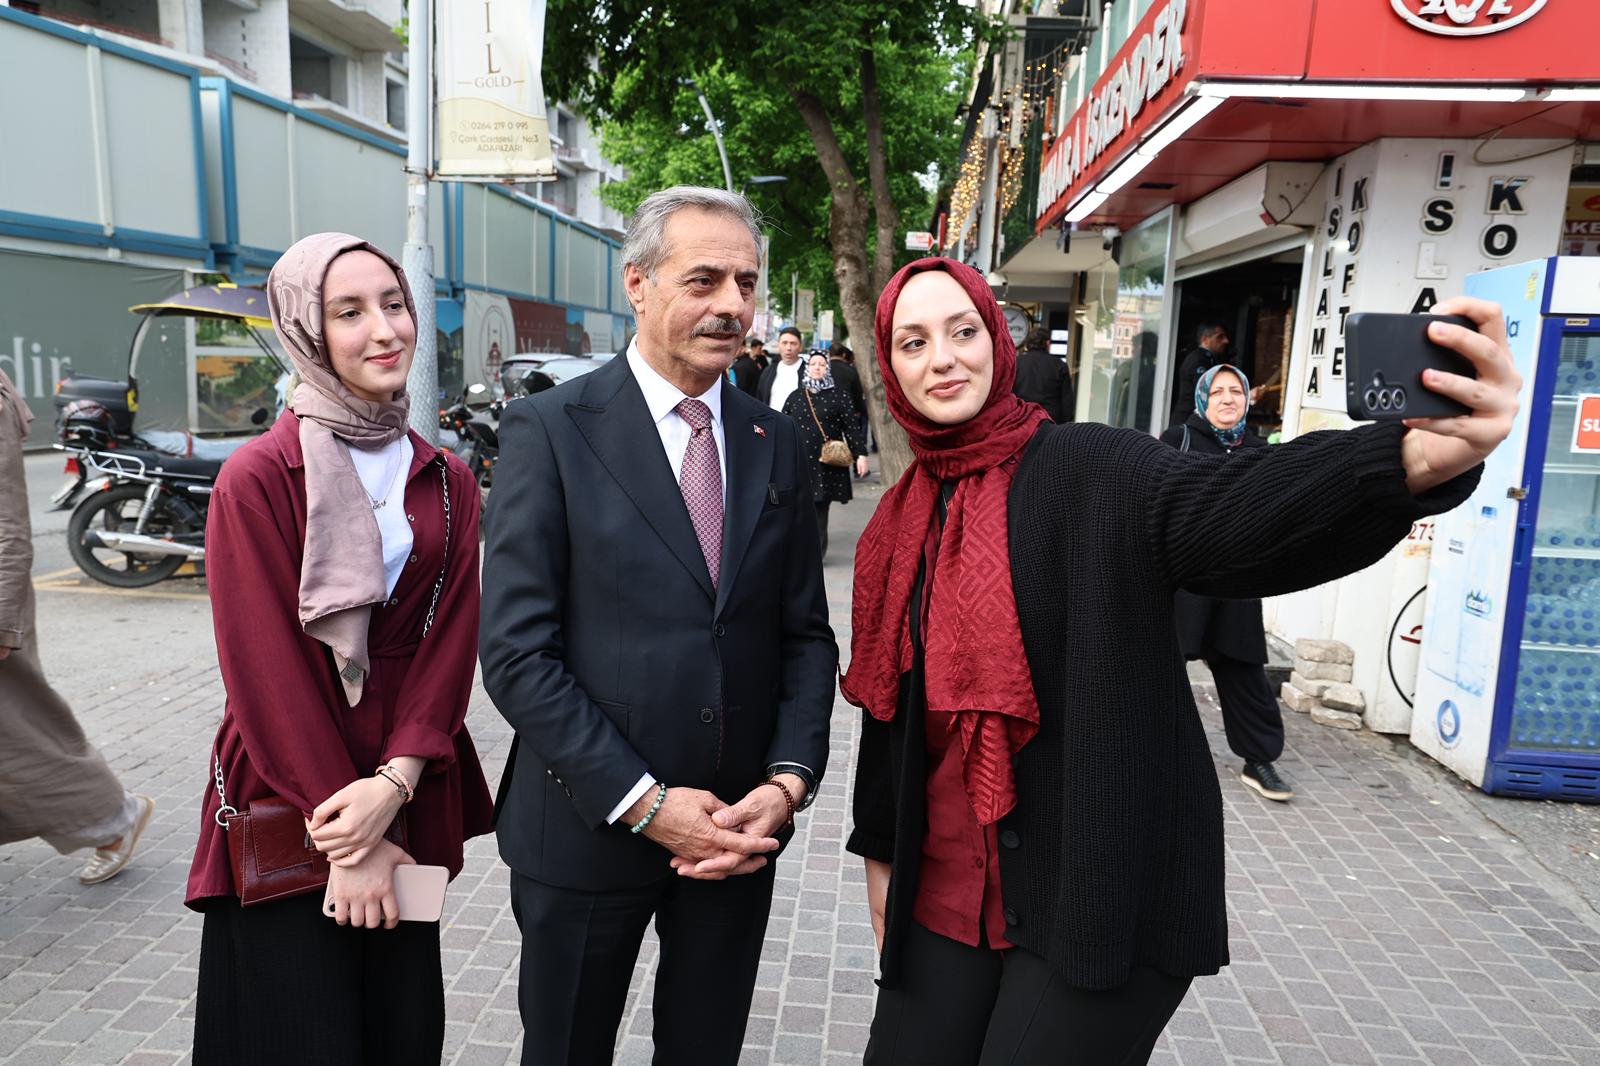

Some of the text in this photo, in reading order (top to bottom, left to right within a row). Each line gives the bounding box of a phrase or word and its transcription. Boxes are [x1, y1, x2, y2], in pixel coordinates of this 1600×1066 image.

[474, 77, 512, 88] GOLD
[1084, 0, 1187, 167] İSKENDER
[471, 121, 491, 130] 0264
[507, 121, 513, 130] 0
[515, 121, 528, 130] 995
[458, 134, 478, 144] Çark
[480, 134, 513, 143] Caddesi
[477, 144, 523, 152] ADAPAZARI
